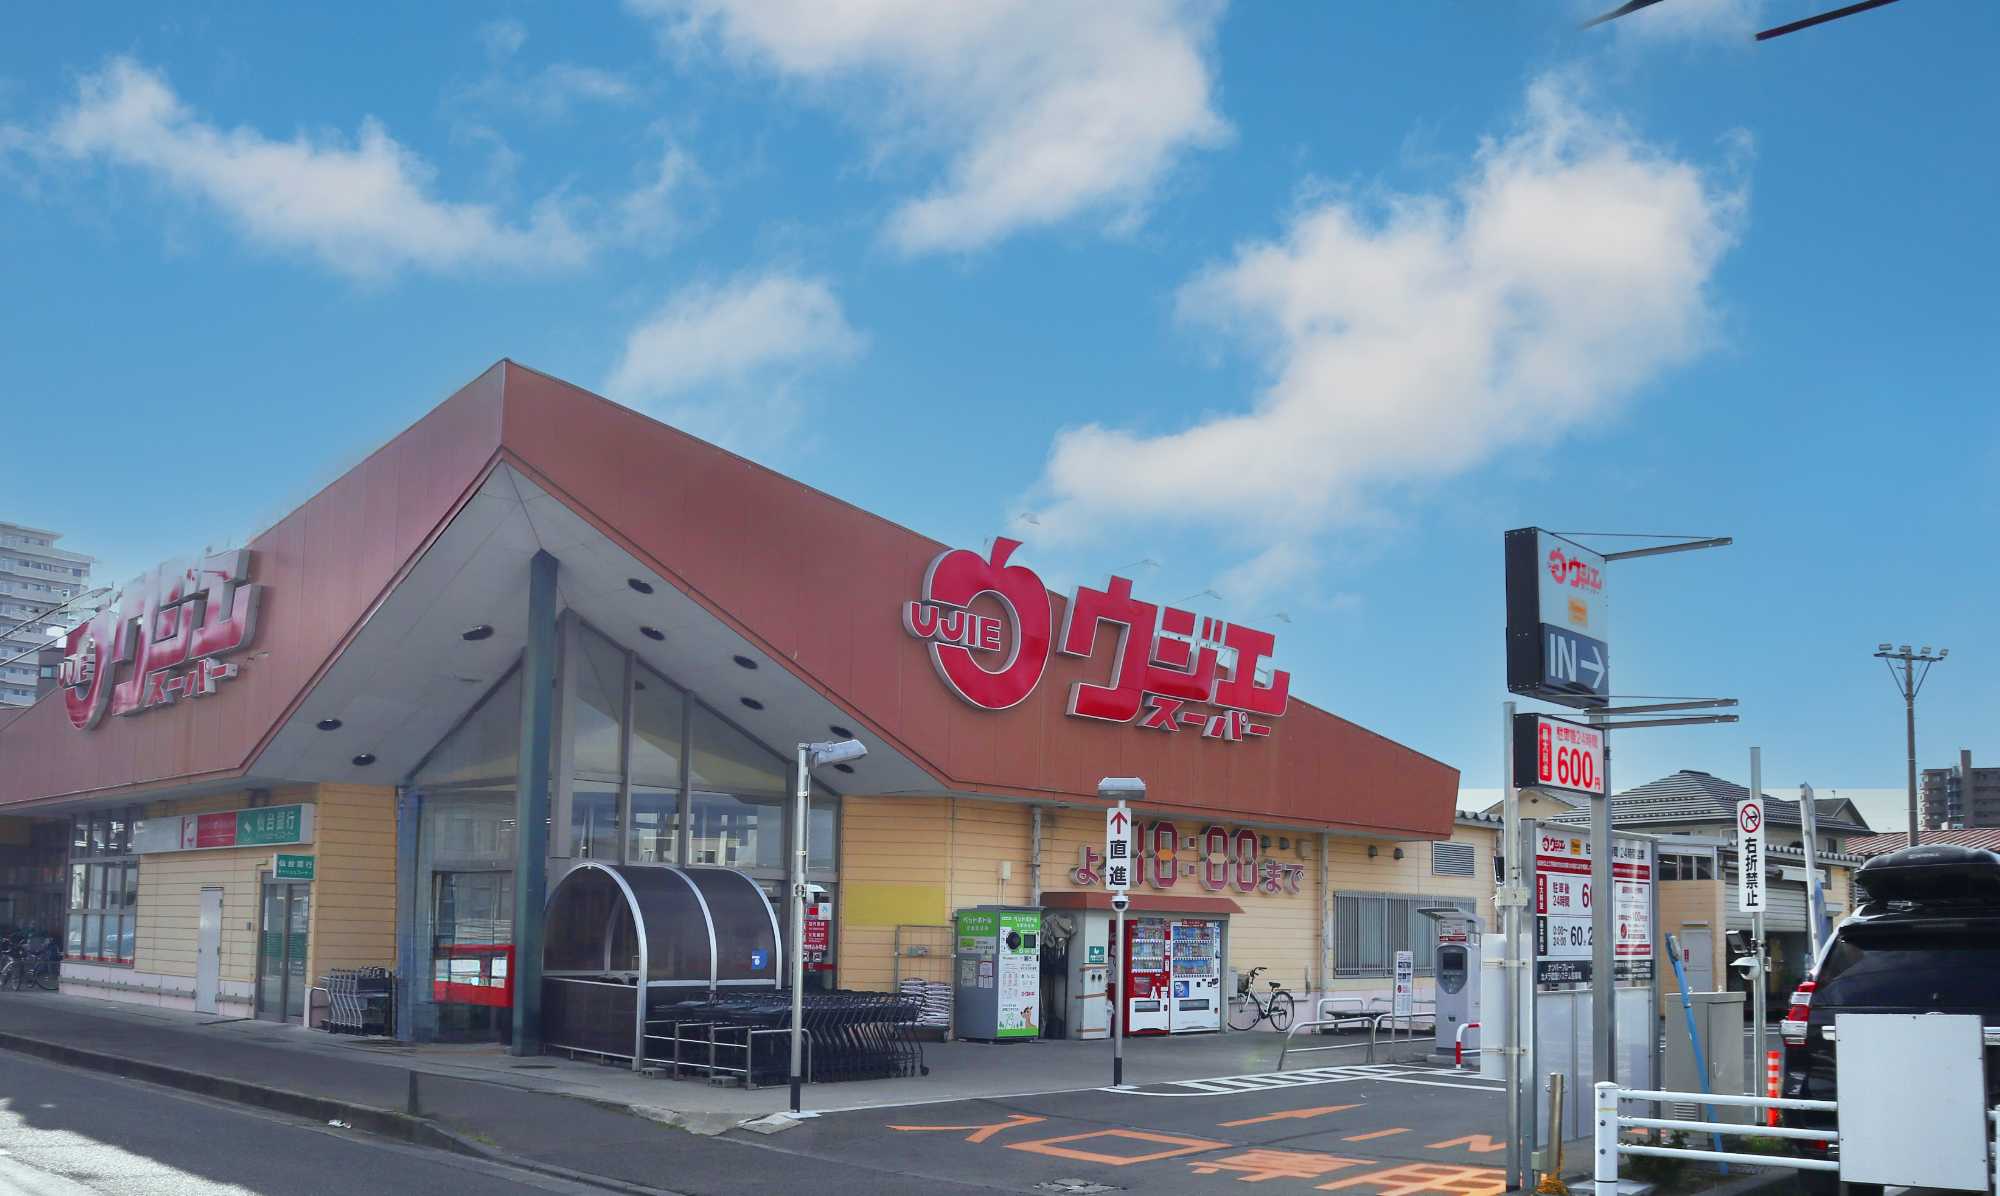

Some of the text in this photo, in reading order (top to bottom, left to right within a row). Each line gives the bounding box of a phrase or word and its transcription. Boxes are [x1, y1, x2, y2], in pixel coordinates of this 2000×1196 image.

[904, 600, 1001, 651] UJIE
[1057, 575, 1291, 722] ウジエ
[1550, 633, 1577, 683] IN
[1137, 695, 1271, 741] スーパー
[1109, 840, 1128, 887] 直進
[1745, 836, 1759, 907] 右折禁止
